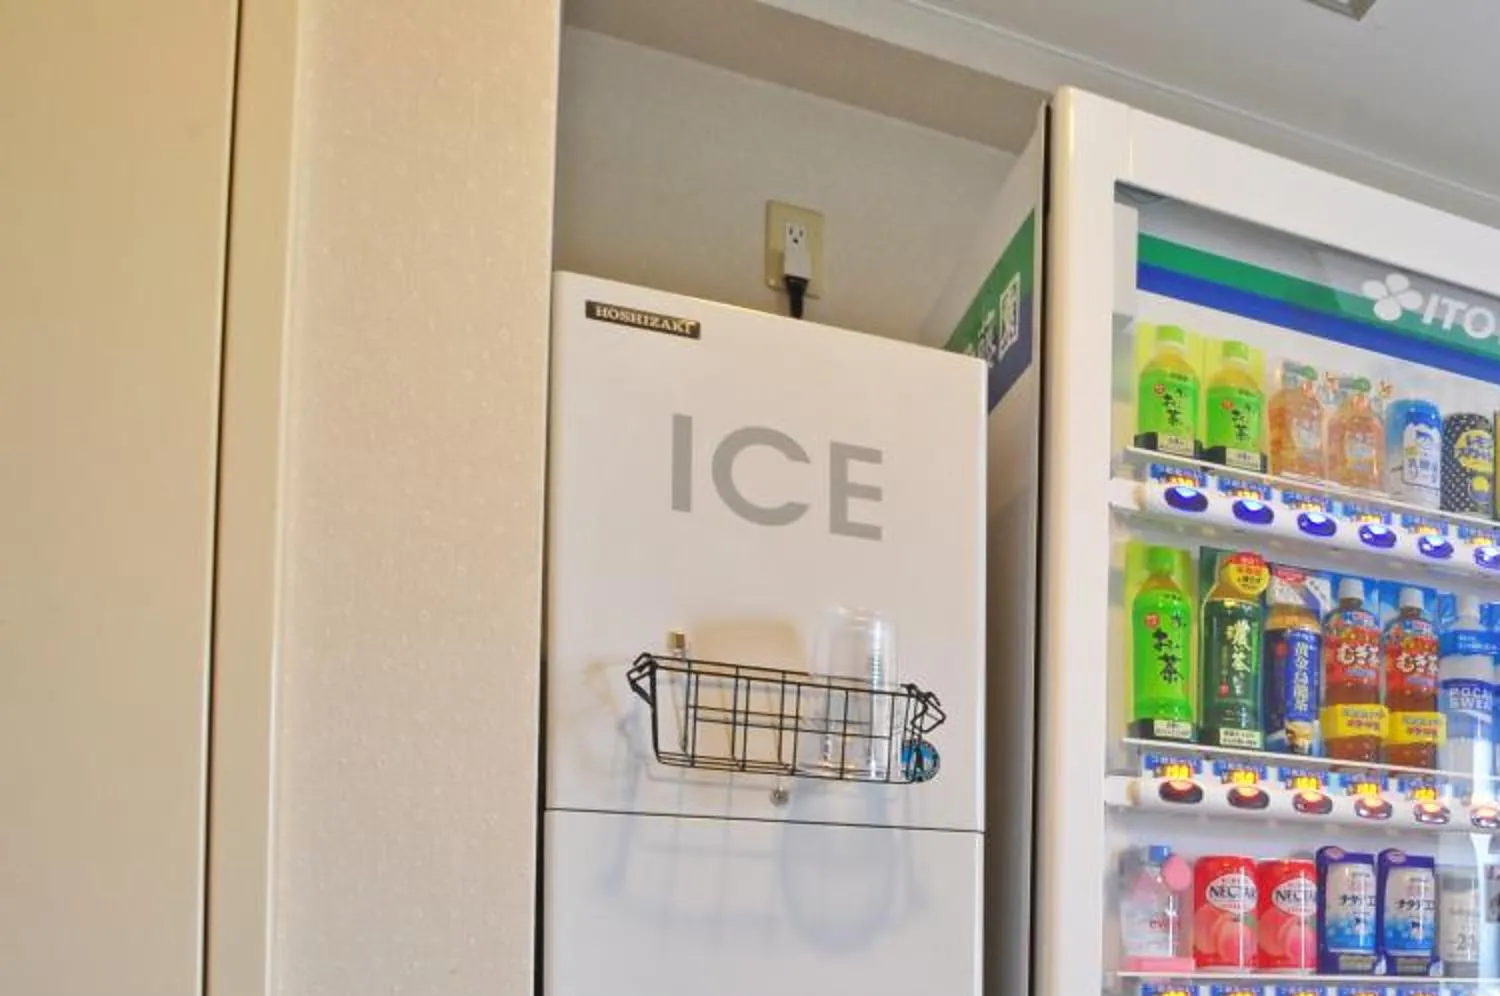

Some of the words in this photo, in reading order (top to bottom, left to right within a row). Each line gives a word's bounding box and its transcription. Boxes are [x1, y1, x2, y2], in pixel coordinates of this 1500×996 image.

[595, 303, 694, 335] HOSHIZAKI
[1420, 298, 1496, 340] ITO
[671, 413, 883, 541] ICE
